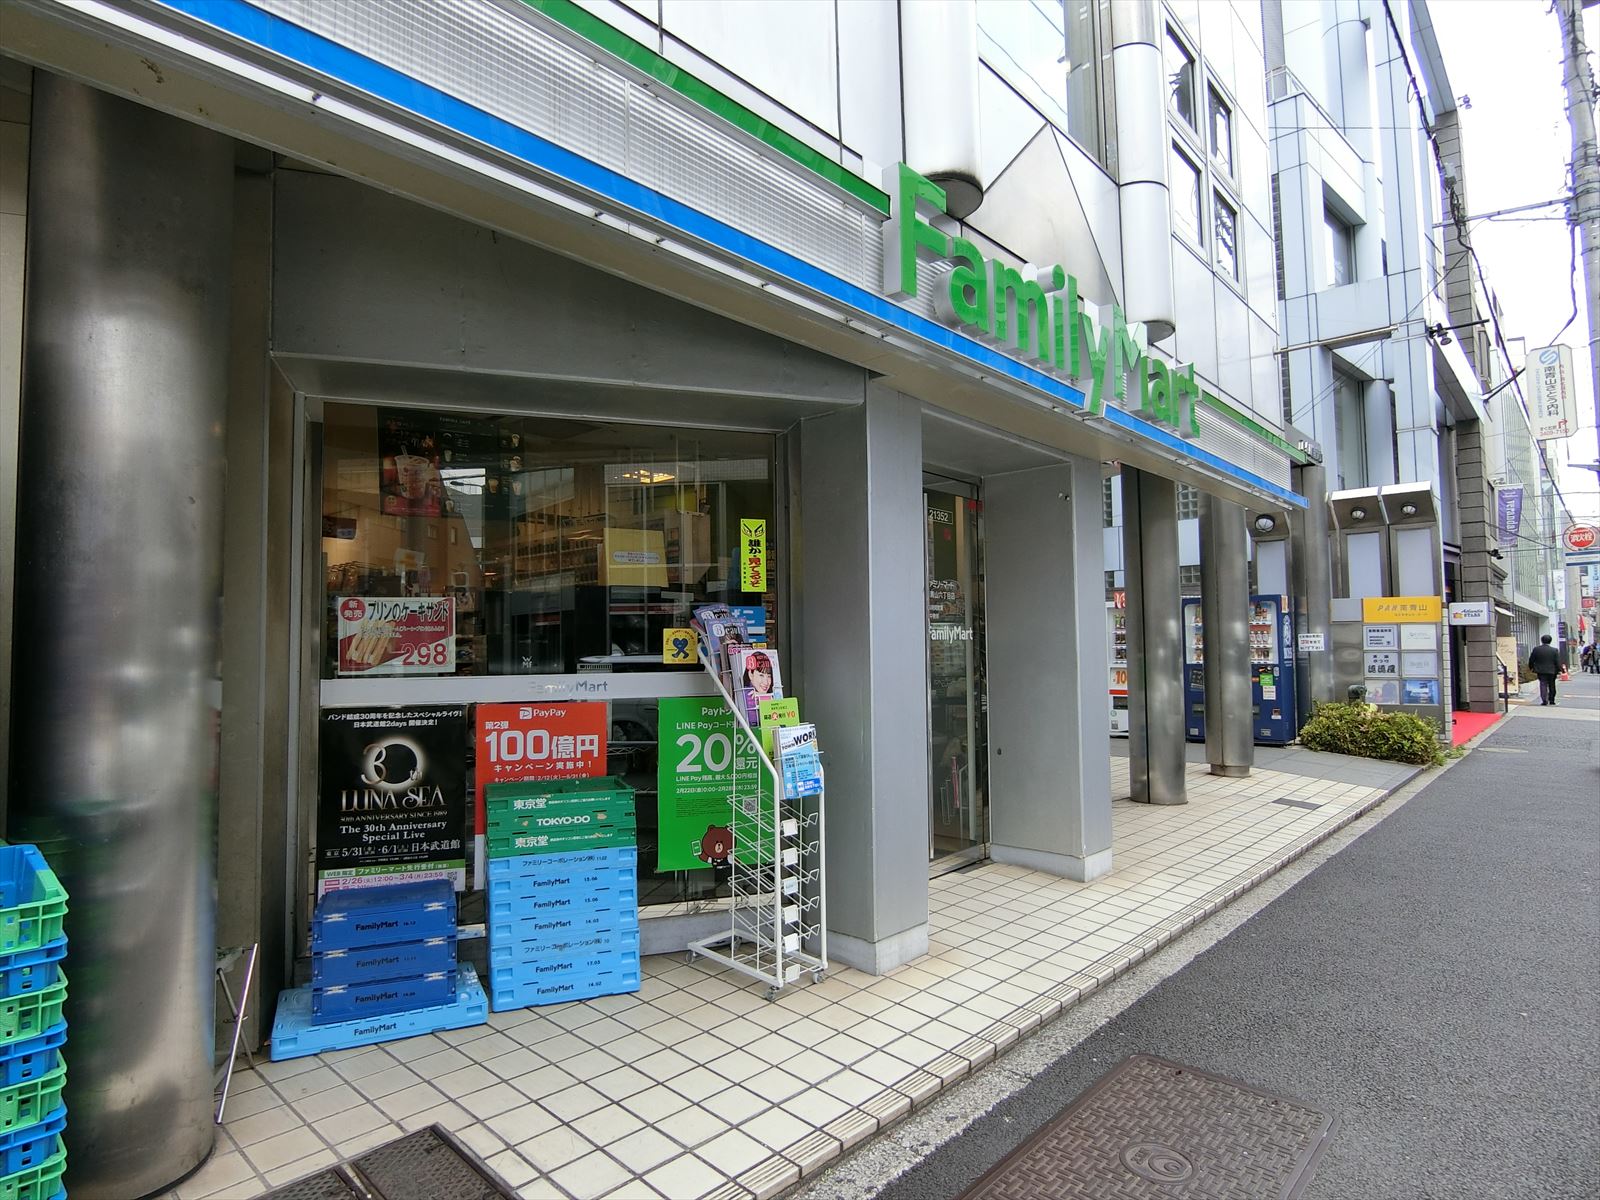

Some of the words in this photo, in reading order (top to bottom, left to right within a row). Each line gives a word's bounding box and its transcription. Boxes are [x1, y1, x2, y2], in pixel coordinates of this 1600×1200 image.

[882, 161, 1200, 438] FamilyMart
[929, 509, 950, 522] 21352
[1571, 532, 1593, 543] 消火栓
[348, 600, 358, 609] 新
[343, 609, 363, 619] 発売
[368, 600, 449, 622] プリンのケーキサンド
[401, 642, 448, 666] 298
[533, 708, 566, 719] PayPay
[485, 721, 509, 730] 第2弾
[676, 721, 696, 730] LINE
[485, 729, 599, 763] 100億円
[493, 760, 592, 772] キャンペーン実施中!
[736, 757, 758, 770] 還元
[340, 788, 398, 812] LUNA
[402, 785, 448, 809] SEA
[513, 797, 547, 810] 東京堂
[355, 813, 408, 822] ANNIVERSARY
[409, 811, 432, 819] SINCE
[536, 815, 591, 826] TOKYO-DO
[339, 825, 361, 834] The
[363, 824, 386, 833] 30th
[389, 821, 448, 831] Anniversary
[362, 832, 400, 844] Special
[403, 831, 426, 840] Live
[514, 835, 549, 849] 東京堂
[411, 839, 461, 853] 日本武道館
[533, 877, 570, 888] FamilyMart
[533, 898, 571, 909] FamilyMart
[355, 920, 399, 931] FamilyMart
[534, 919, 572, 931] FamilyMart
[356, 956, 400, 969] FamilyMart
[535, 962, 573, 974] FamilyMart
[536, 984, 574, 995] FamilyMart
[355, 991, 398, 1004] FamilyMart
[353, 1022, 397, 1036] FamilyMart
